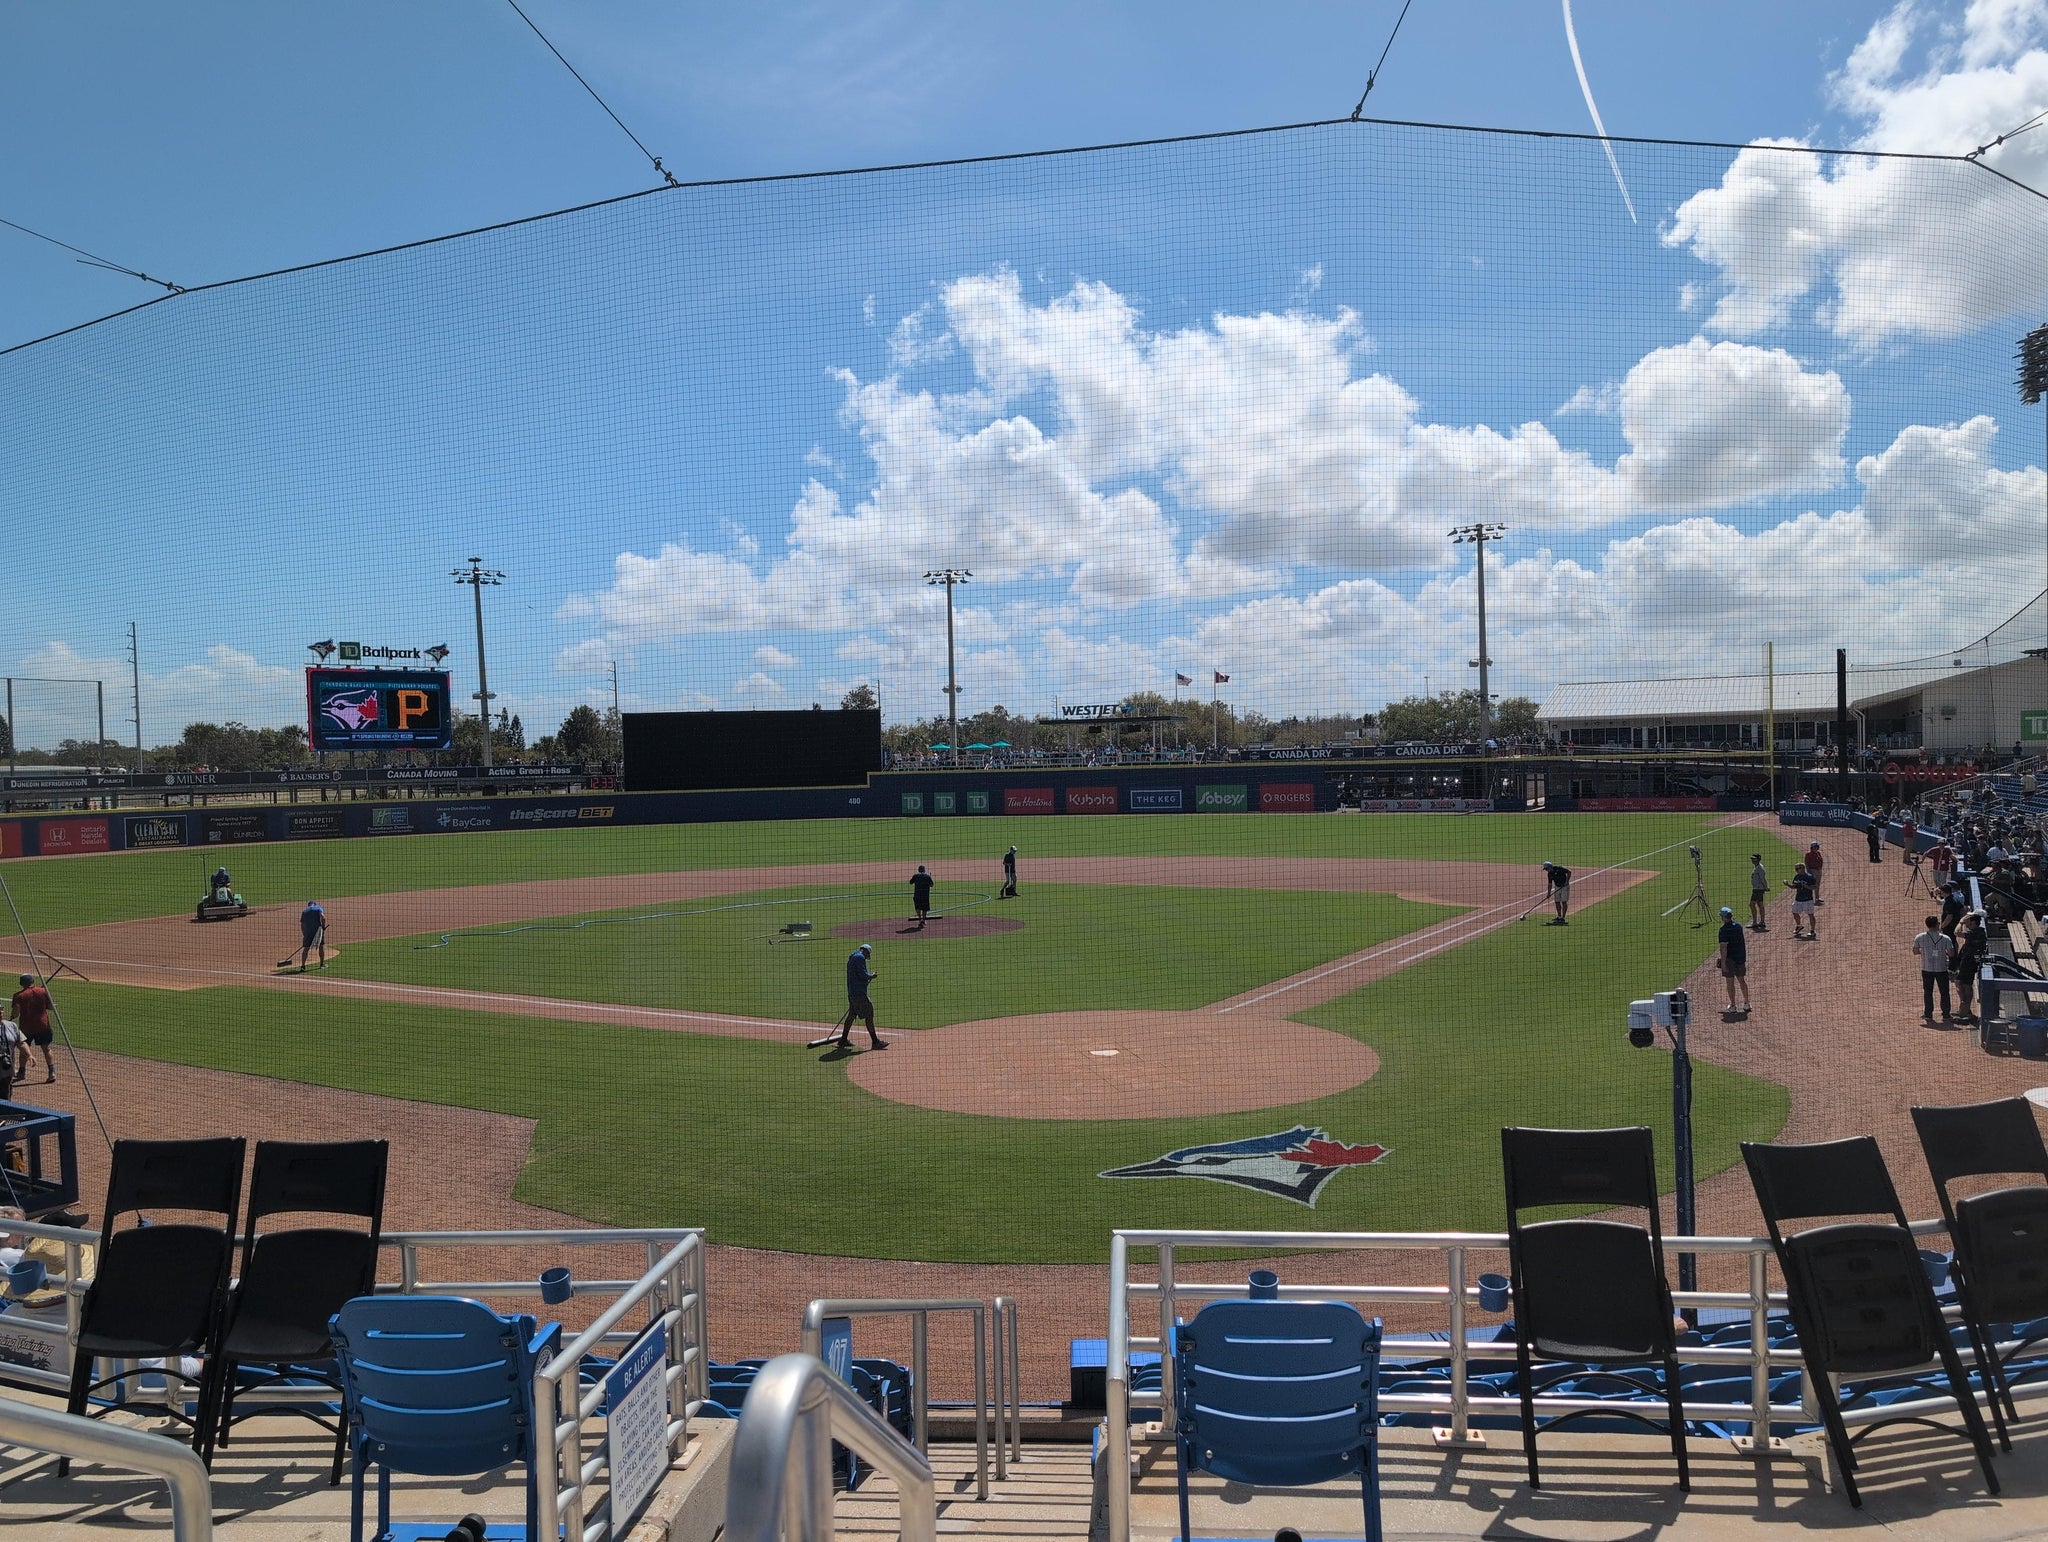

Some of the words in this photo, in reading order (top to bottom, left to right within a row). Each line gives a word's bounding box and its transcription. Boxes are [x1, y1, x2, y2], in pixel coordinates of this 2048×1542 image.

[362, 645, 421, 660] Ballpark
[396, 689, 429, 730] P
[1061, 704, 1119, 717] WESTJET
[1268, 750, 1310, 760] CANADA
[1312, 750, 1332, 758] DRY
[1395, 746, 1441, 756] CANADA
[1443, 746, 1465, 755] DRY
[290, 772, 330, 780] BAUSER'S
[387, 770, 422, 778] CANADA
[424, 770, 458, 778] MOVING
[488, 767, 516, 776] Active
[1904, 764, 1979, 782] ROGERS
[10, 780, 40, 788] DUNEDIN
[40, 778, 88, 788] REFRIGERATION
[176, 774, 216, 785] MILNER
[1022, 796, 1053, 807] Hortons
[1069, 794, 1114, 805] Kubota
[1136, 796, 1156, 804] THE
[1158, 795, 1176, 803] KEG
[1274, 793, 1311, 802] ROGERS
[1753, 800, 1771, 808] 326
[510, 808, 578, 821] theScore
[580, 808, 612, 817] BET
[1828, 808, 1851, 820] HEINZ
[452, 817, 492, 829] BayCare
[18, 1334, 56, 1356] Training
[624, 1366, 632, 1389] BE
[633, 1343, 652, 1379] ALERT!
